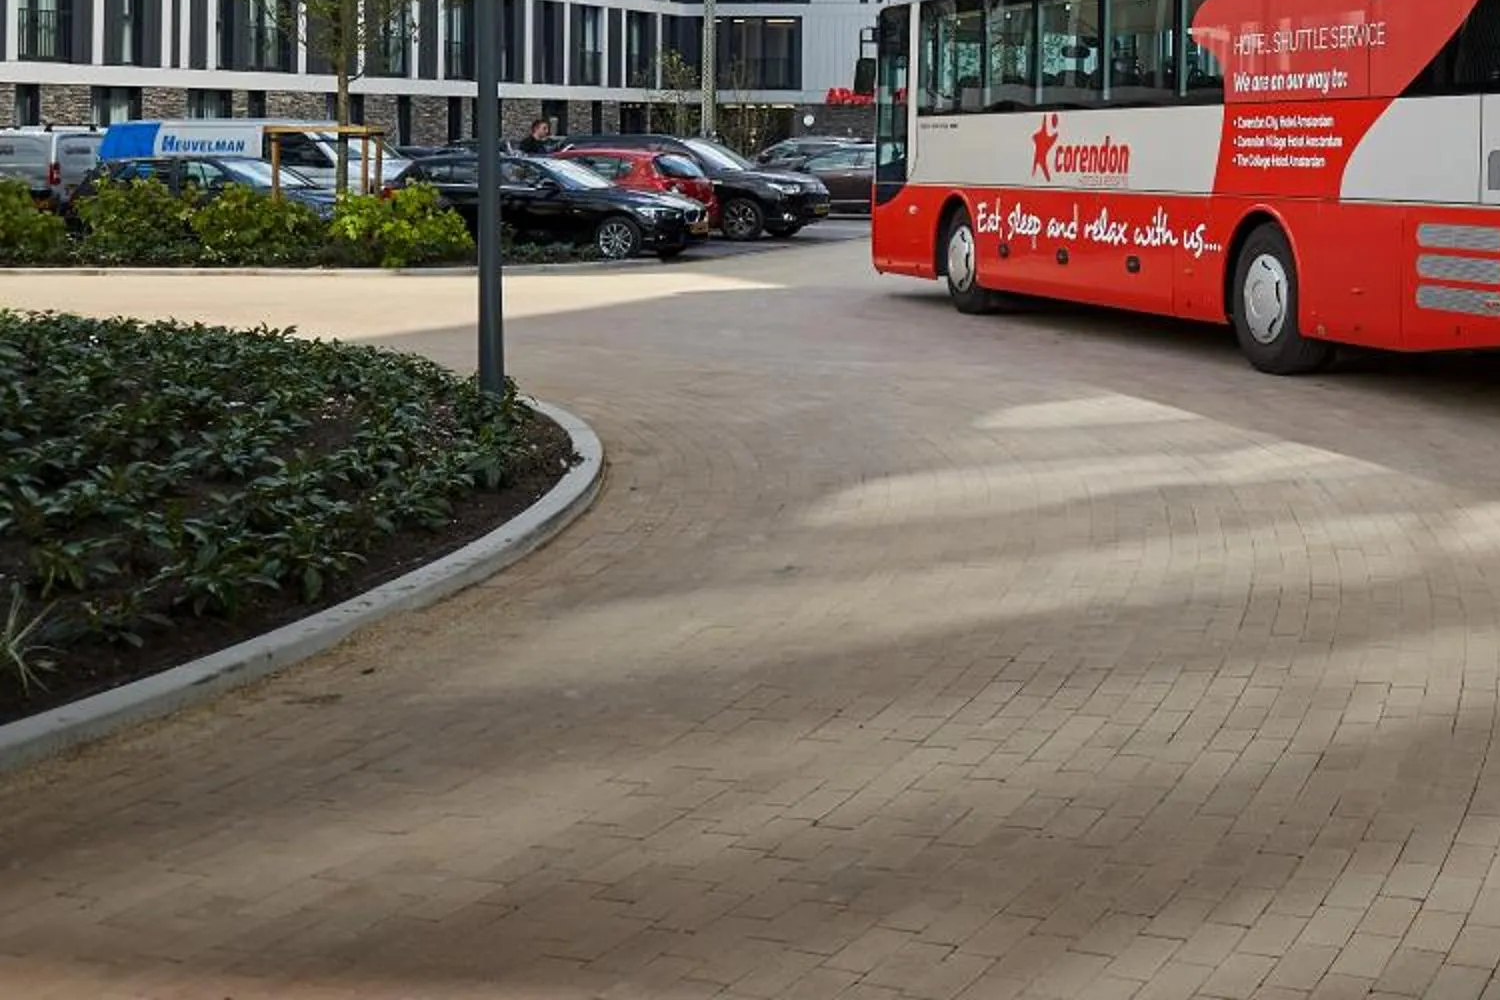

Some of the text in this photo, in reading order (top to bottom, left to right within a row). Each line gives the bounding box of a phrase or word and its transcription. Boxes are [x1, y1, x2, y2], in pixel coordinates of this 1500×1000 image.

[1234, 22, 1386, 56] HOTEL SHUTTLE SERVICE
[1234, 68, 1348, 94] We are on our way to:
[162, 135, 245, 153] HEUVELMAN
[1055, 135, 1129, 174] corendon
[1007, 202, 1041, 249] sleep
[1047, 203, 1078, 238] and
[1084, 207, 1128, 244] relax
[1133, 206, 1178, 247] with
